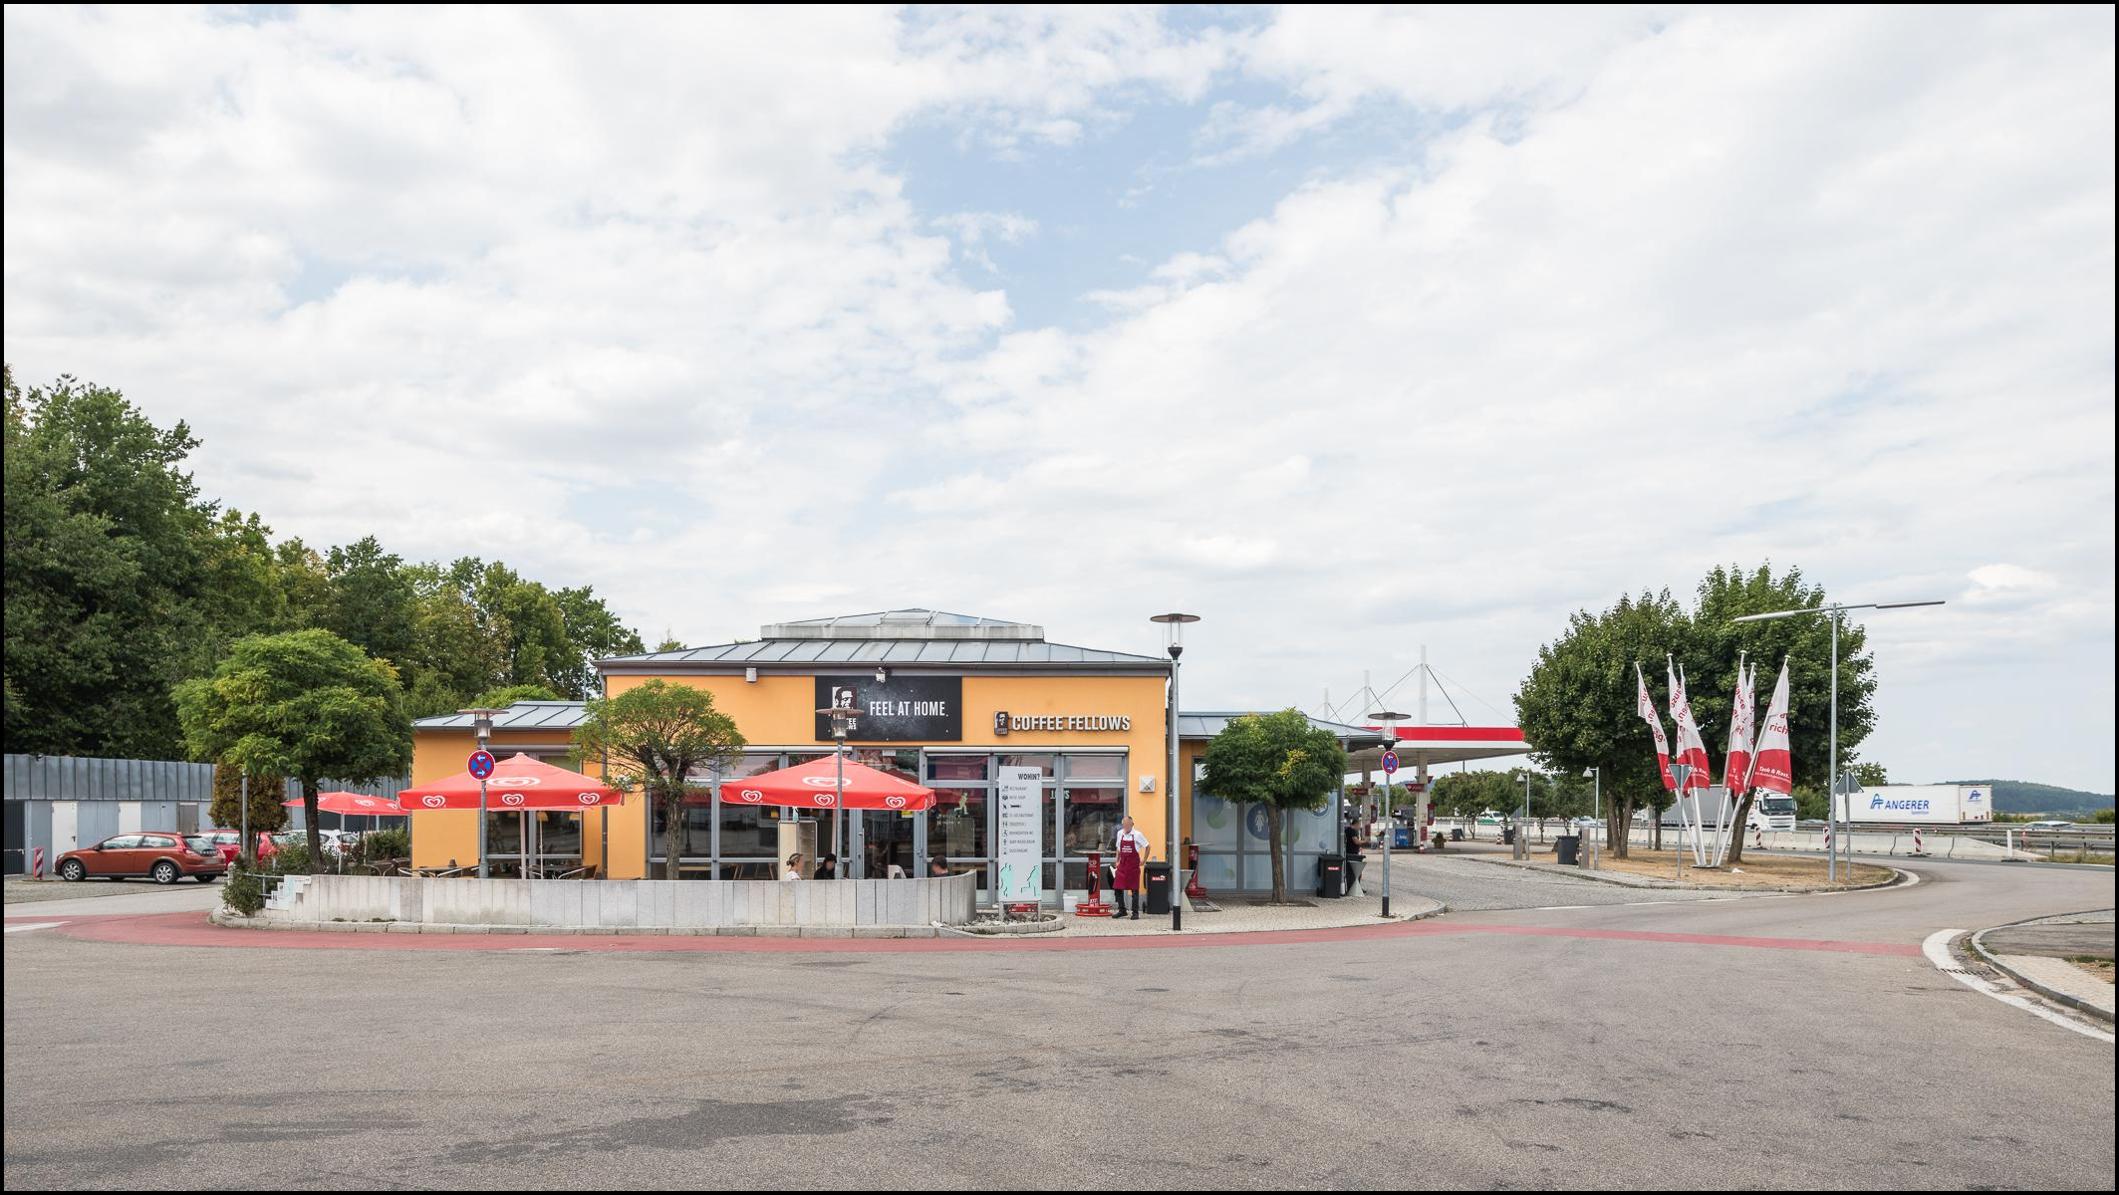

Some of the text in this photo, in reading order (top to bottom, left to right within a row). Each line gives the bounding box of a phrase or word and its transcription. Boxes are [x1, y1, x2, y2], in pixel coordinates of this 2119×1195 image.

[869, 701, 949, 717] FEEL AT HOME.
[1012, 715, 1130, 730] COFFEE FELLOWS
[1885, 800, 1930, 810] ANGERER
